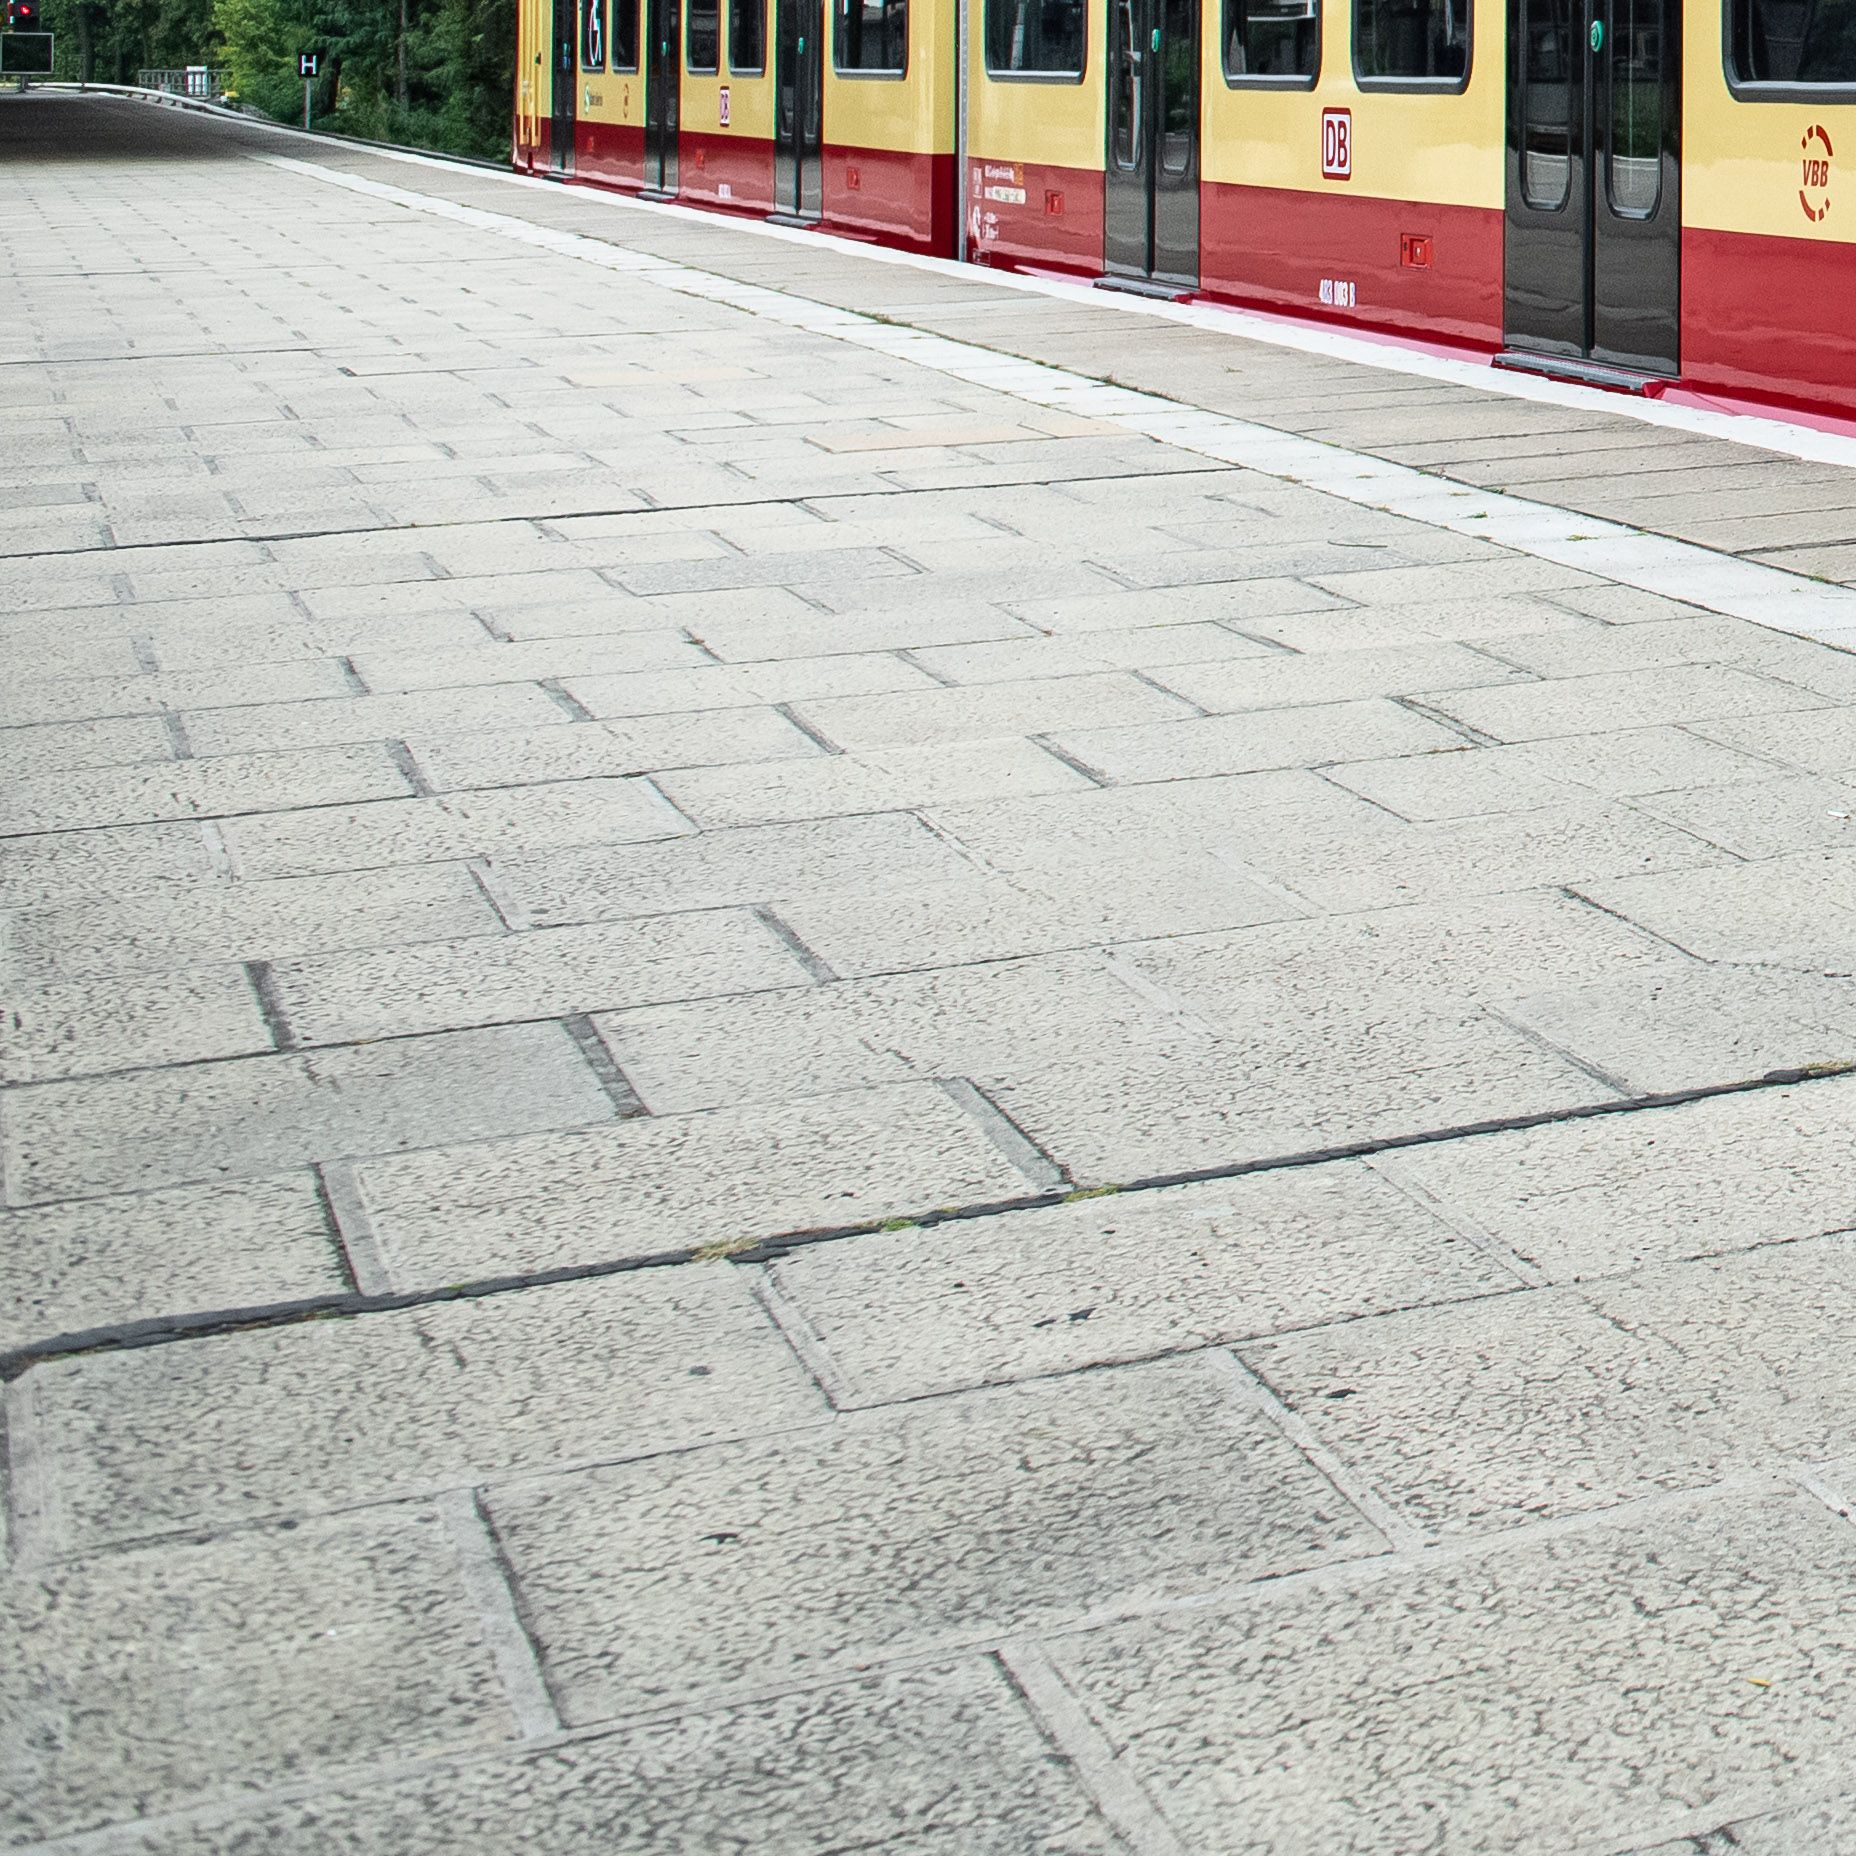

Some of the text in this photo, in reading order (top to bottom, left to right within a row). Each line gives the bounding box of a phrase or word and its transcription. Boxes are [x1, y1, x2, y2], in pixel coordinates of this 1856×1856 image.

[301, 54, 317, 75] H
[1326, 119, 1348, 168] DB
[1802, 159, 1829, 187] VBB
